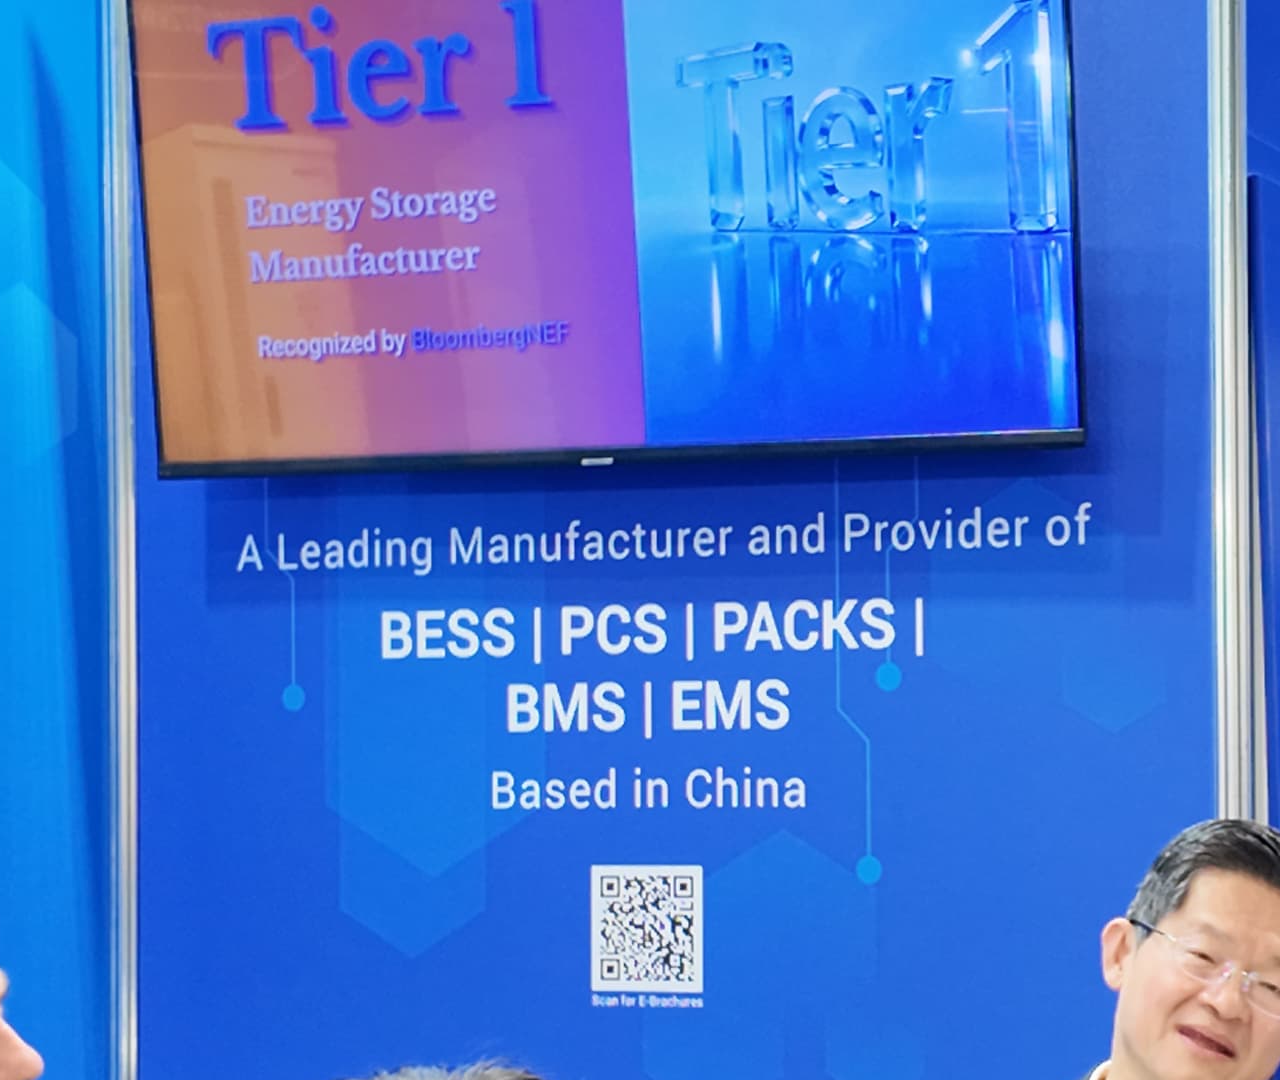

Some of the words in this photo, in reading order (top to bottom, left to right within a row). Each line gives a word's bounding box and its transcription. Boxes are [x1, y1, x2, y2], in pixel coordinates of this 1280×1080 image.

[207, 4, 470, 131] Tier
[499, 0, 554, 108] 1
[676, 41, 954, 232] Tier
[975, 0, 1060, 233] 1
[245, 194, 365, 233] Energy
[370, 186, 498, 224] Storage
[248, 242, 481, 284] Manufacturer
[258, 329, 376, 362] Recognized
[381, 328, 407, 358] by
[412, 320, 570, 351] BloombergNEF
[236, 533, 264, 573] A
[277, 526, 433, 576] Leading
[449, 519, 734, 566] Manufacturer
[747, 511, 826, 556] and
[843, 506, 1030, 553] Provider
[1045, 502, 1093, 547] of
[380, 607, 516, 660] BESS
[560, 603, 668, 656] PCS
[713, 598, 896, 653] PACKS
[506, 681, 626, 733] BMS
[672, 678, 791, 732] EMS
[491, 767, 617, 810] Based
[633, 767, 669, 810] in
[685, 766, 807, 810] China
